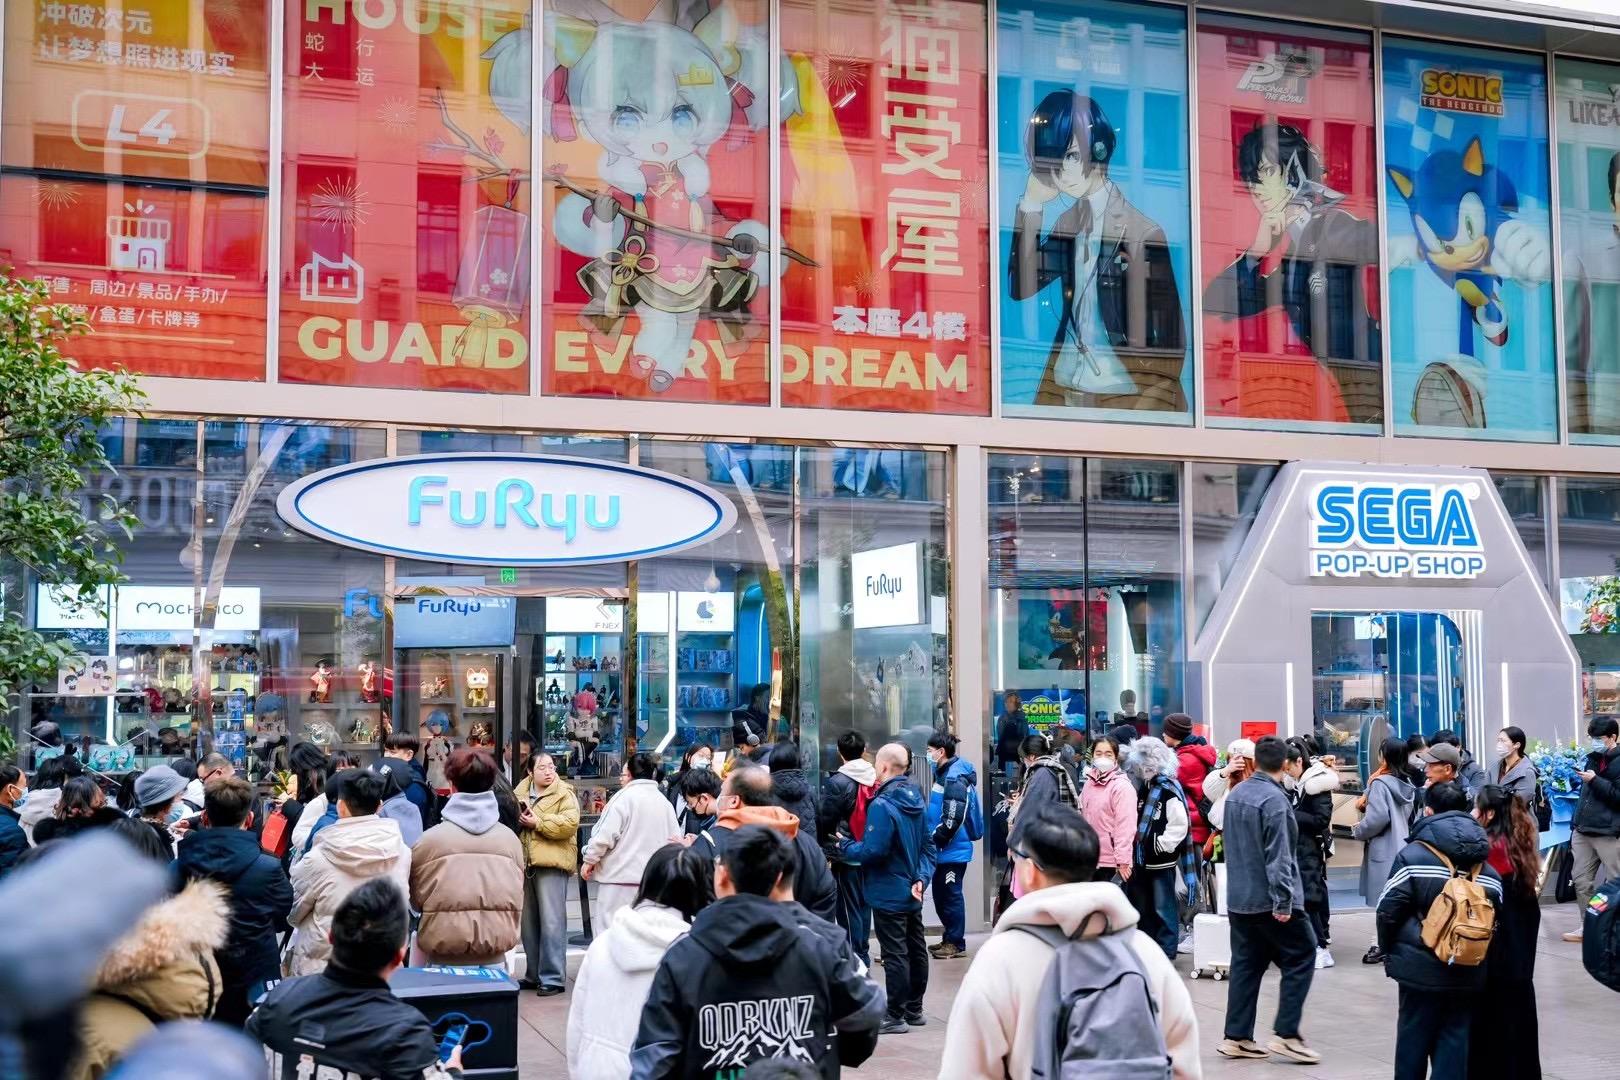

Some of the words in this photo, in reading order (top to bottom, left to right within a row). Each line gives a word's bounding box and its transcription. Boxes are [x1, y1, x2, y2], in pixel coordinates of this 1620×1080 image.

[38, 2, 153, 35] 冲破次元
[39, 33, 236, 77] 让梦想照进现实
[1422, 71, 1502, 103] SONIC
[1423, 97, 1442, 107] THE
[1448, 100, 1503, 114] HEDGEHOG
[106, 104, 177, 145] L4
[555, 330, 741, 381] EVRY
[764, 344, 968, 393] DREAM
[408, 475, 621, 543] FuRyu
[1317, 486, 1478, 546] SEGA
[1317, 554, 1409, 574] POP-UP
[1417, 557, 1483, 575] SHOP
[866, 573, 902, 598] FuRyu
[418, 599, 482, 616] FuRyu
[1022, 703, 1061, 714] SONIC
